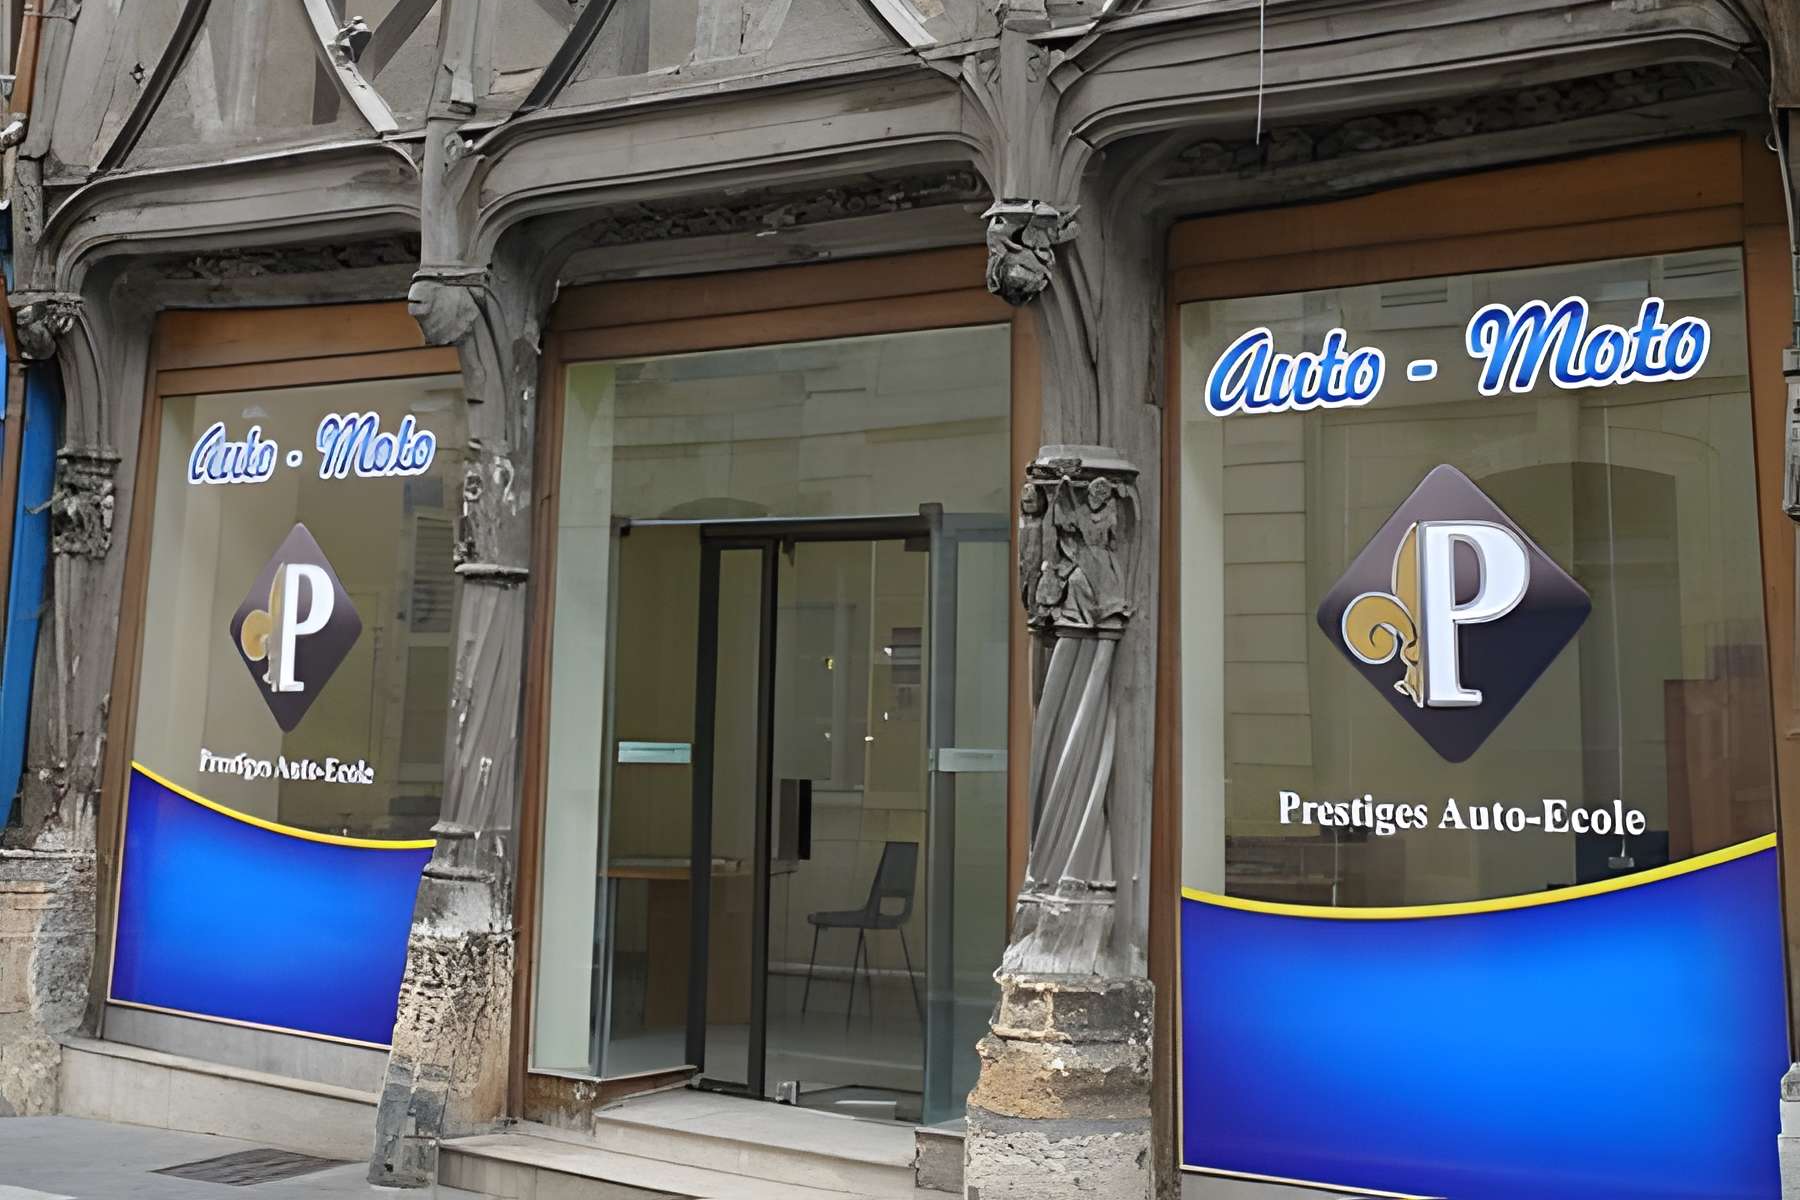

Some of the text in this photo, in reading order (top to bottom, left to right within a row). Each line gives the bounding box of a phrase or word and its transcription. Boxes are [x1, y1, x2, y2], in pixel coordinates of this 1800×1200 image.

[1205, 296, 1711, 417] Auto - Moto
[188, 422, 278, 484] Auto
[316, 411, 437, 480] Moto
[279, 563, 335, 692] P
[1417, 520, 1530, 707] P
[1279, 791, 1646, 836] Prestiges Auto-Ecole
